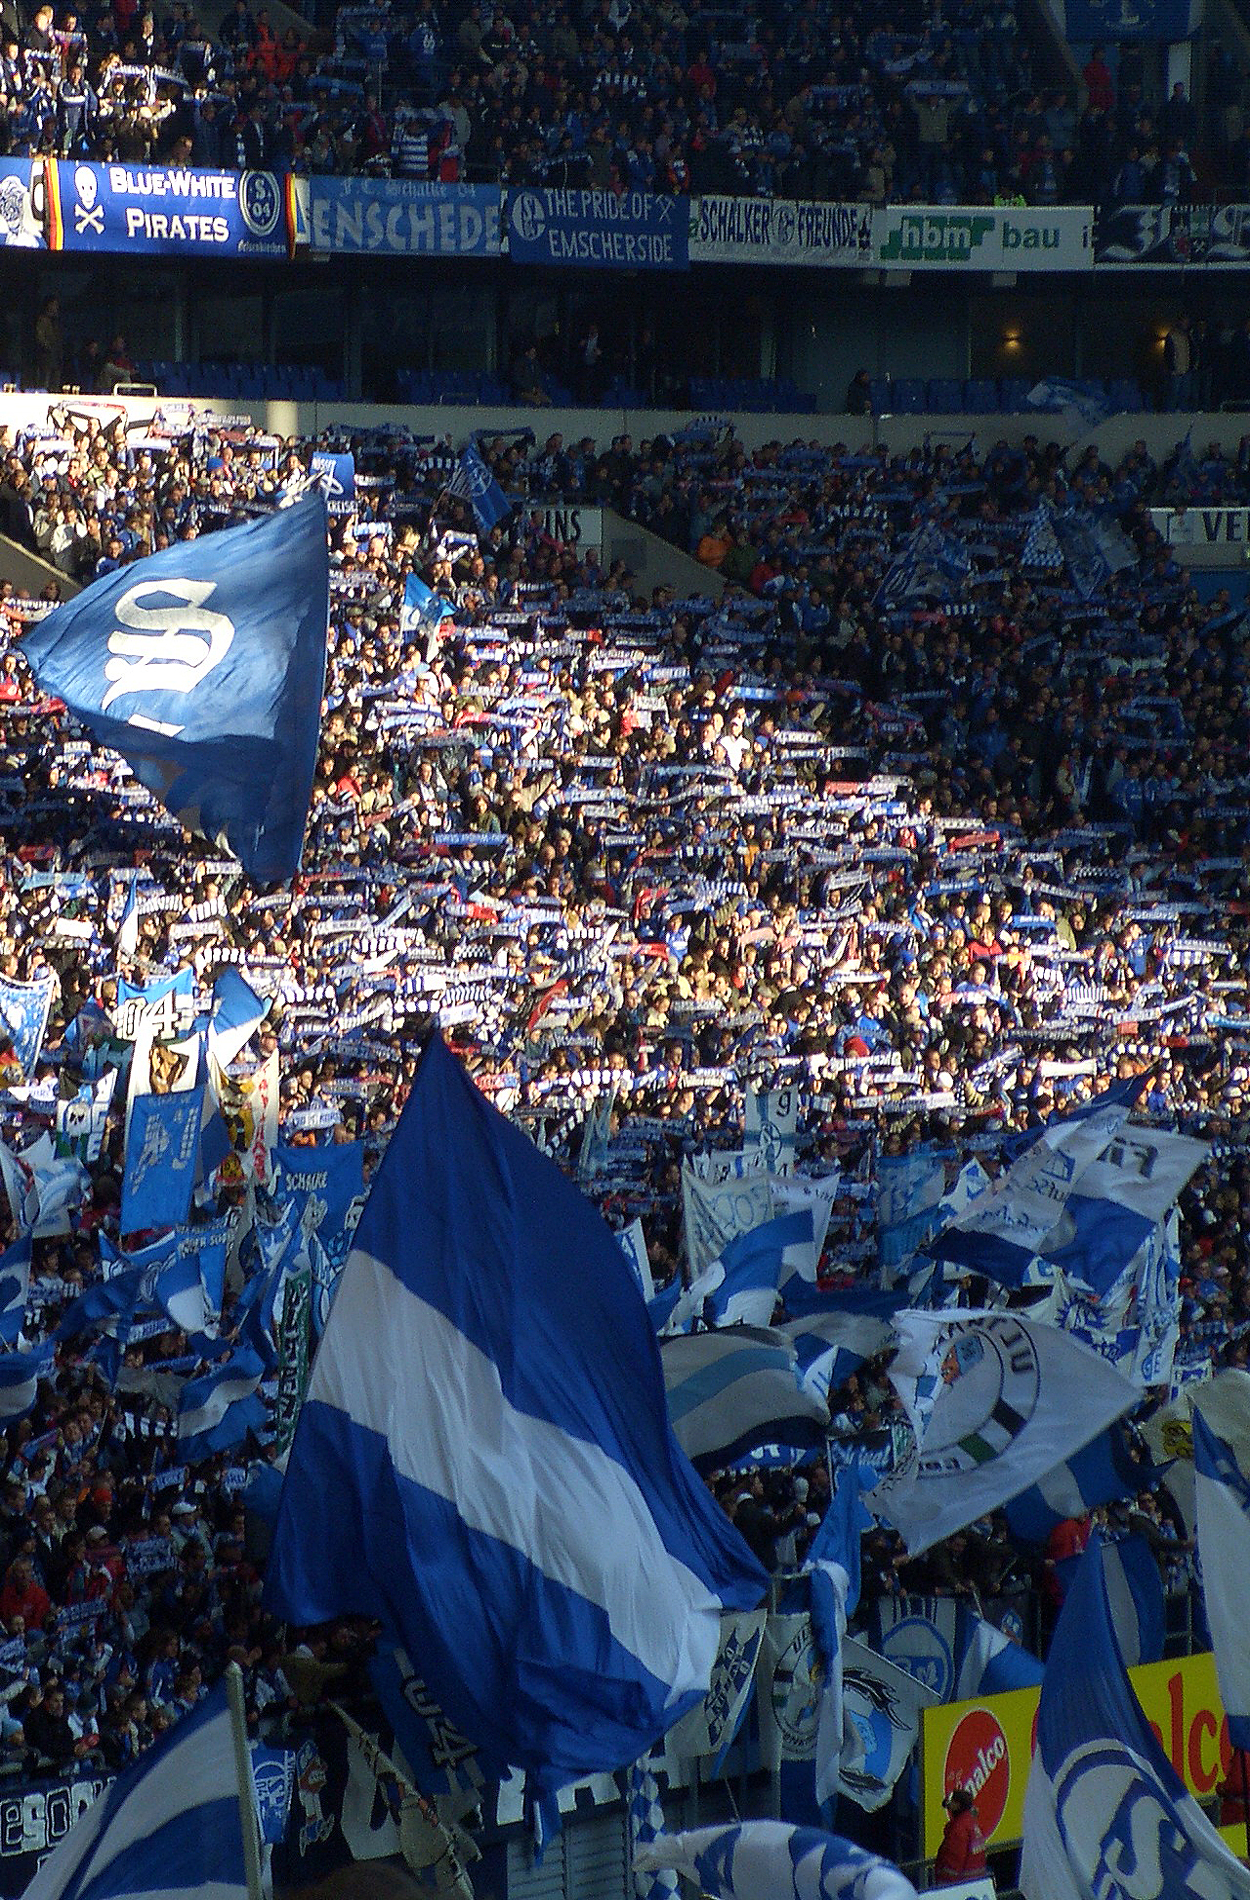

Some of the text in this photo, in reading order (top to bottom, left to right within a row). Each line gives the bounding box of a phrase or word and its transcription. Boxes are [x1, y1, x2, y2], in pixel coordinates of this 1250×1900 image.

[545, 188, 653, 220] THE PRIDE OF
[127, 208, 230, 243] PIRATES
[311, 199, 500, 252] ENSCHEDE
[700, 196, 858, 249] SCHALKER FREUNDE
[901, 217, 971, 250] hbm
[1002, 221, 1061, 250] bau
[548, 228, 674, 263] EMSCHERSIDE
[285, 1170, 329, 1192] SCHALKE
